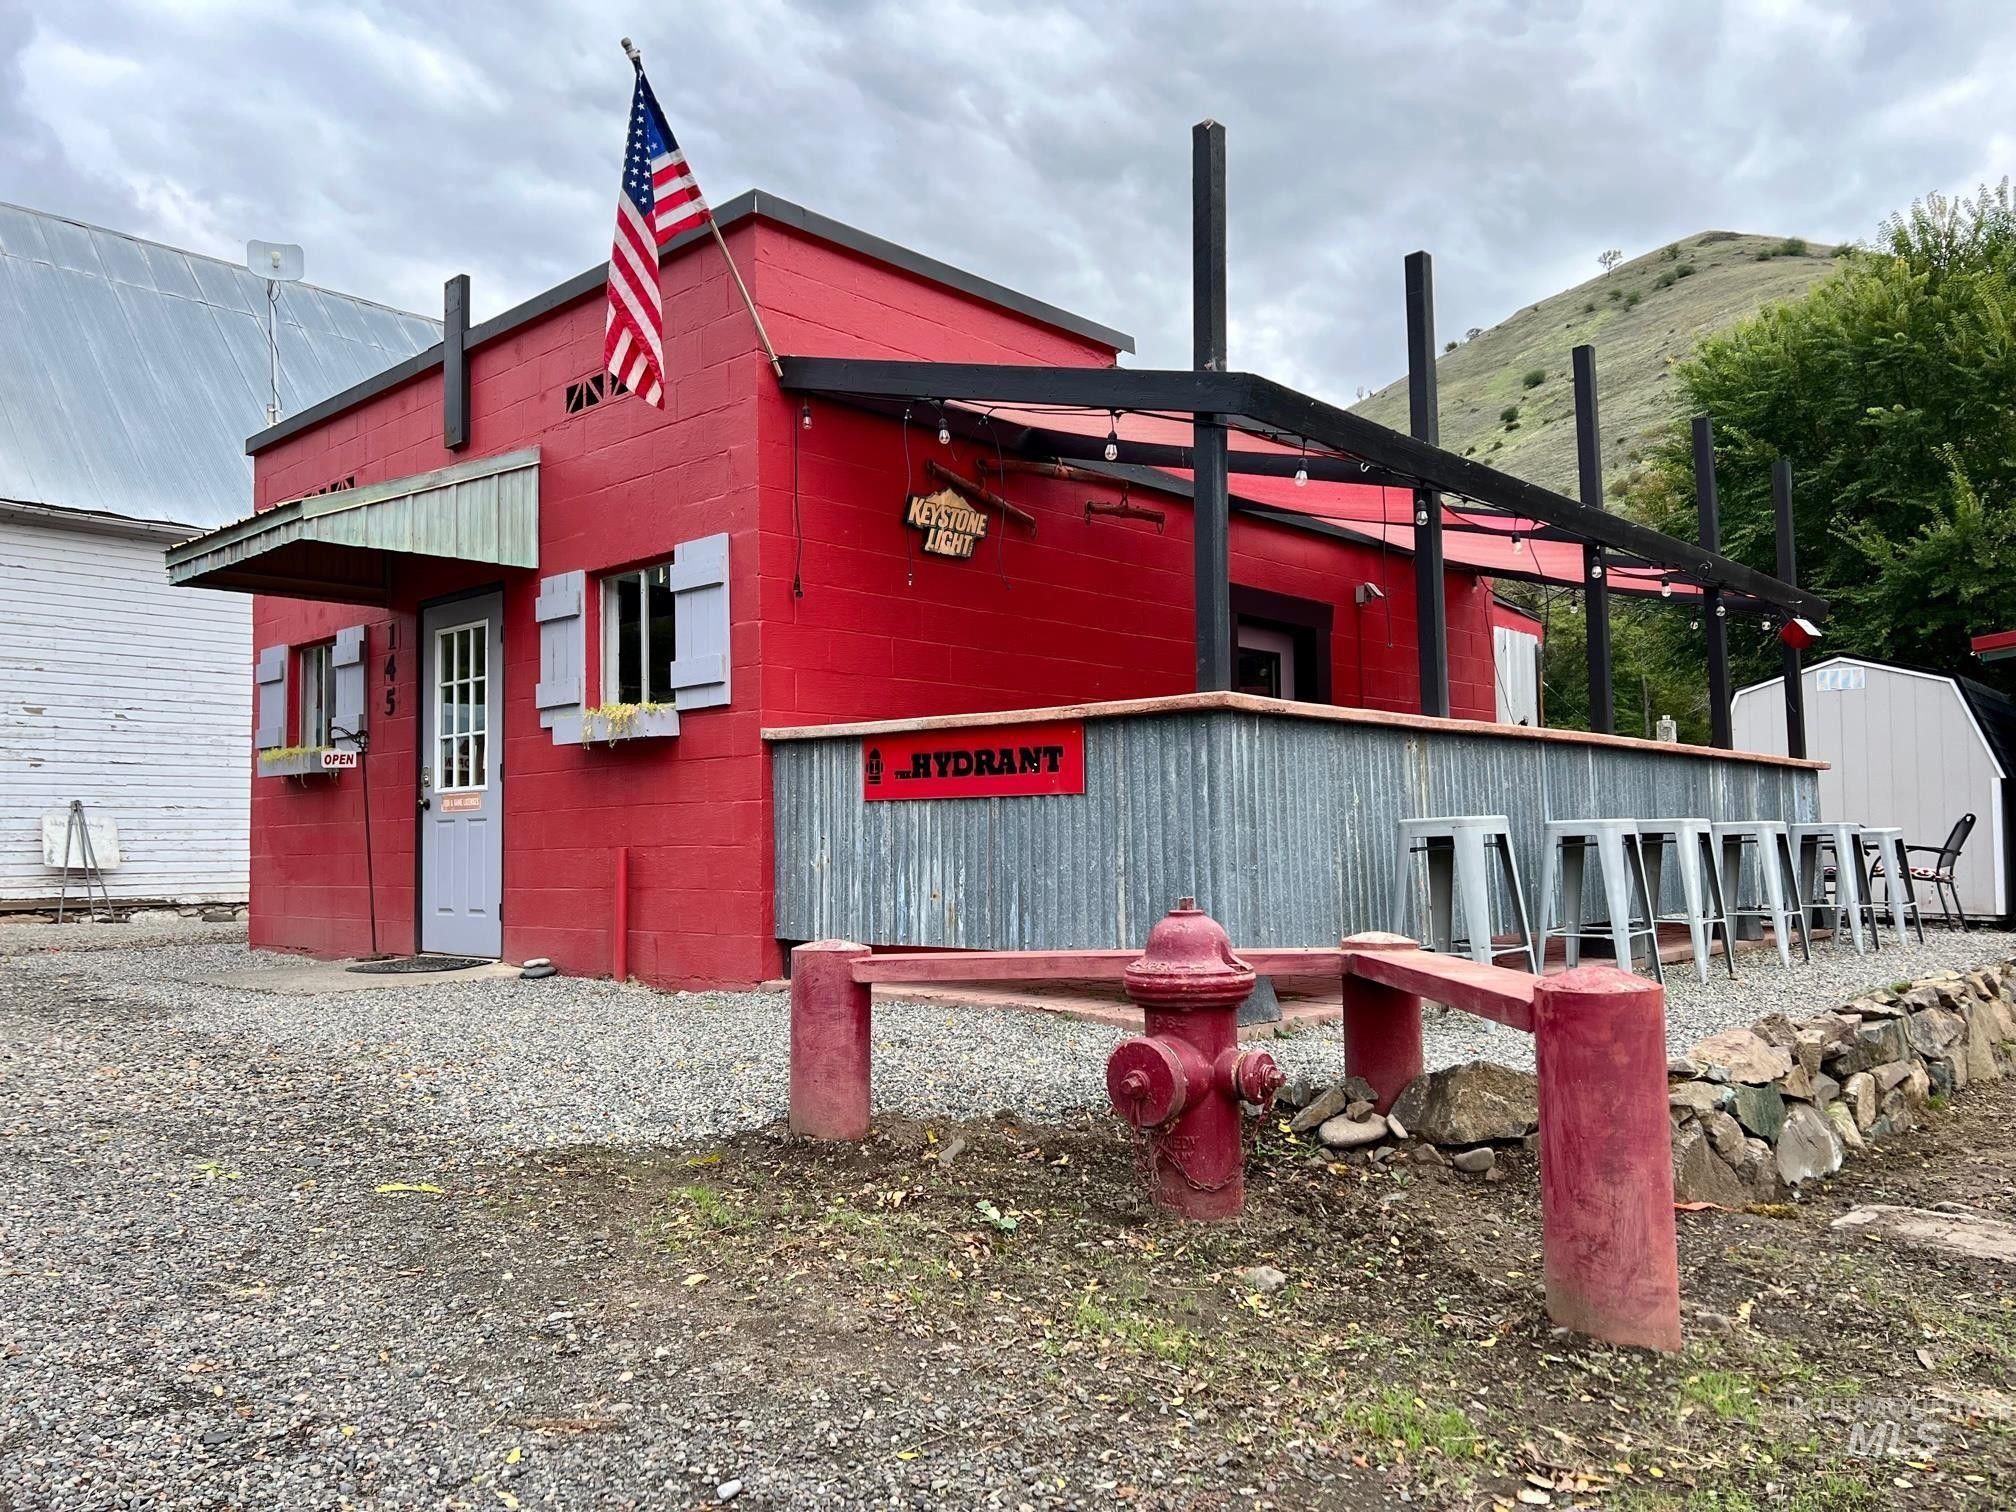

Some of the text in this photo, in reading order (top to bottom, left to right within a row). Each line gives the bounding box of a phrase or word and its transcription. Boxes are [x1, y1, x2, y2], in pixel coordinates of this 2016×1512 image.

[909, 497, 988, 535] KEYSTONE
[925, 529, 974, 556] LIGHT
[384, 624, 397, 716] 145
[324, 754, 354, 765] OPEN
[911, 746, 1063, 779] HYDRANT
